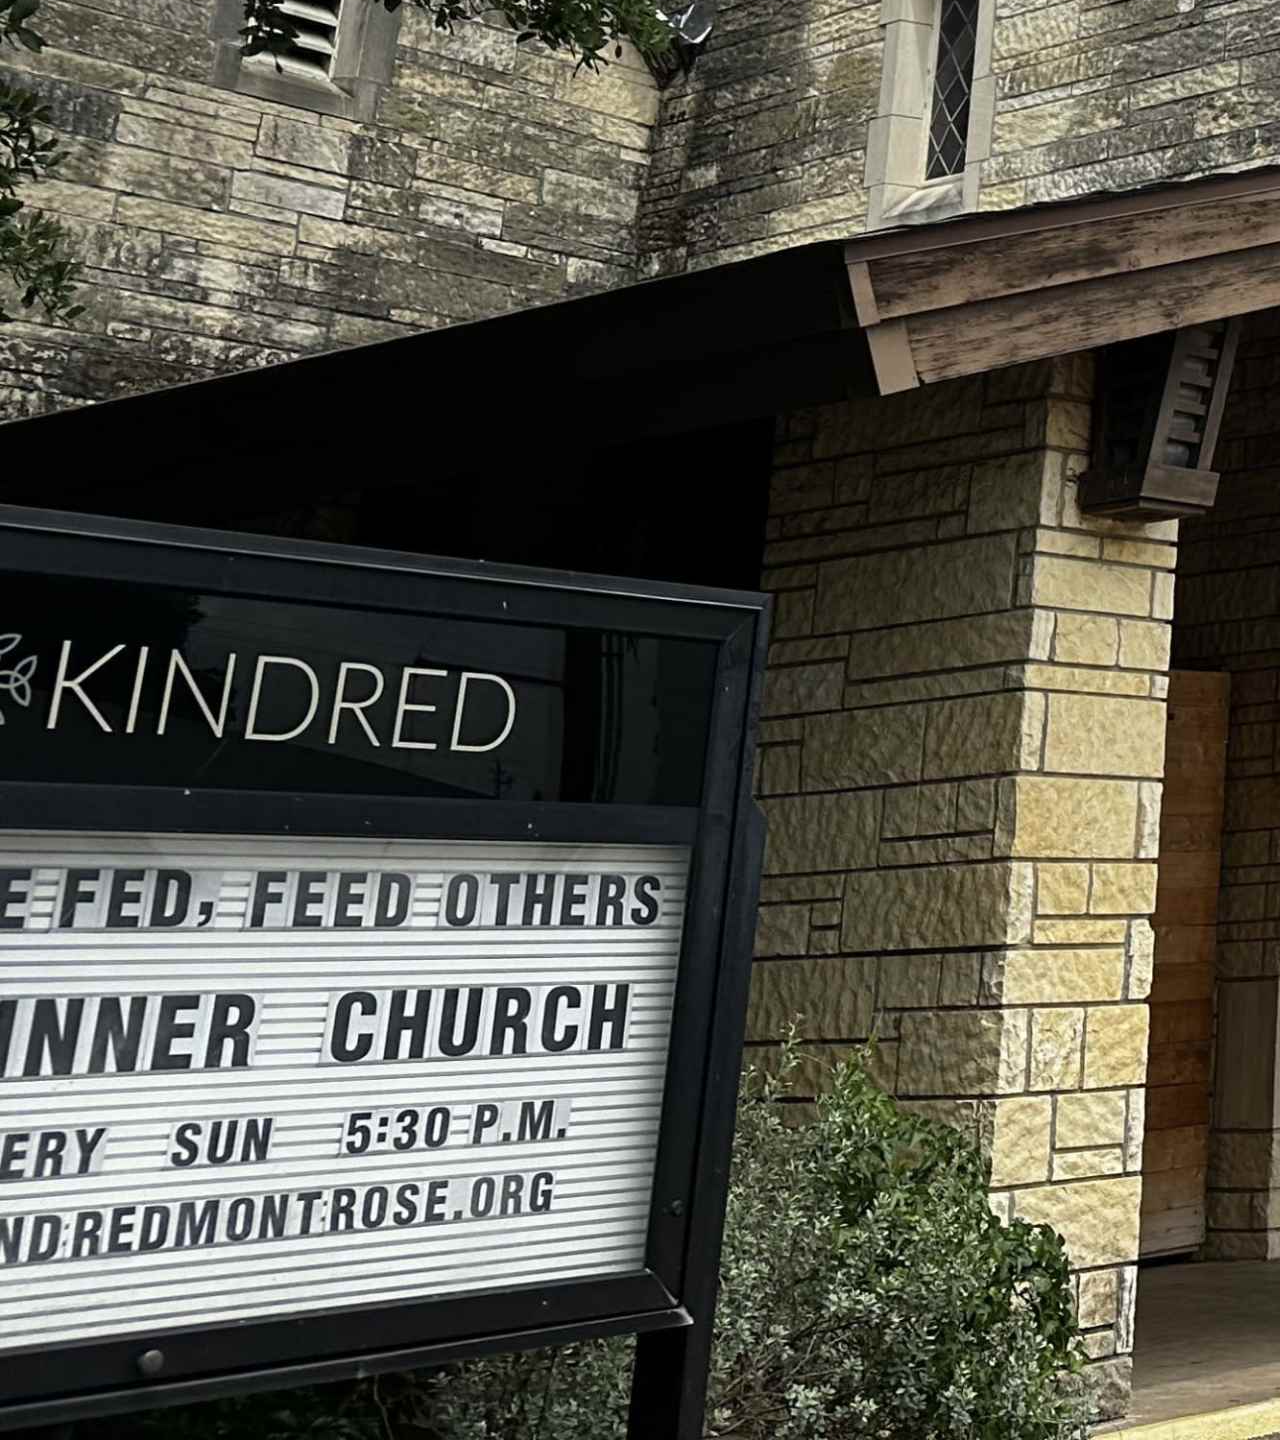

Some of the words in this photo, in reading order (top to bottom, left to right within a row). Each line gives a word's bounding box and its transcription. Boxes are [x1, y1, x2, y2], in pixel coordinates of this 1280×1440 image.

[47, 640, 516, 752] KINDRED
[59, 869, 214, 928] FED,
[250, 871, 409, 928] FEED
[445, 873, 661, 926] OTHERS
[330, 984, 630, 1062] CHURCH
[0, 1128, 106, 1179] ERY
[171, 1117, 273, 1166] SUN
[345, 1107, 451, 1154] 5:30
[472, 1100, 567, 1145] P.M.
